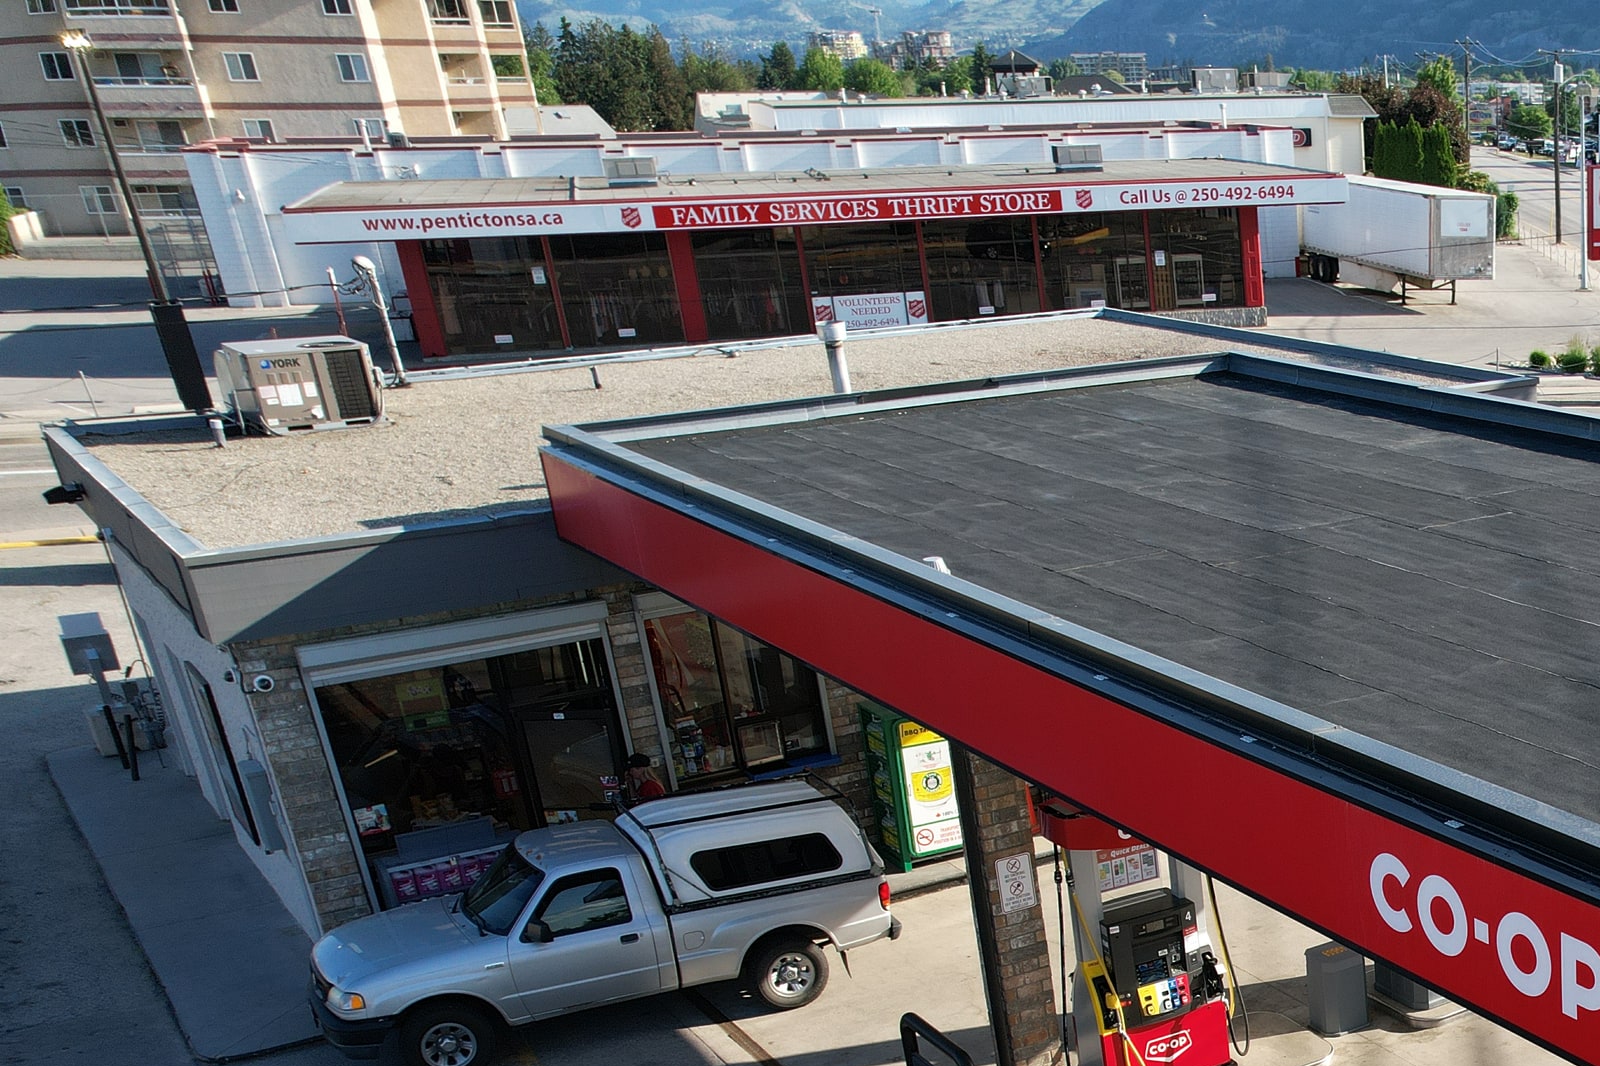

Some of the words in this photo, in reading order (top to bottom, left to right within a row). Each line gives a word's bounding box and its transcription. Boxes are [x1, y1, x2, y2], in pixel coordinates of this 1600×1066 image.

[1119, 190, 1148, 204] Call
[1152, 189, 1171, 203] Us
[1175, 192, 1187, 203] @
[1191, 185, 1295, 201] 250-492-6494
[671, 203, 759, 226] FAMILY
[768, 199, 879, 221] SERVICES
[887, 196, 974, 217] THRIFT
[979, 192, 1053, 212] STORE
[362, 209, 564, 232] www.pentictonsa.ca
[838, 296, 901, 307] VOLUNTEERS
[851, 306, 891, 316] NEEDED
[846, 318, 899, 328] 250-492-6494
[270, 358, 301, 368] YORK
[1111, 848, 1130, 858] QUICK
[1186, 911, 1192, 921] 4
